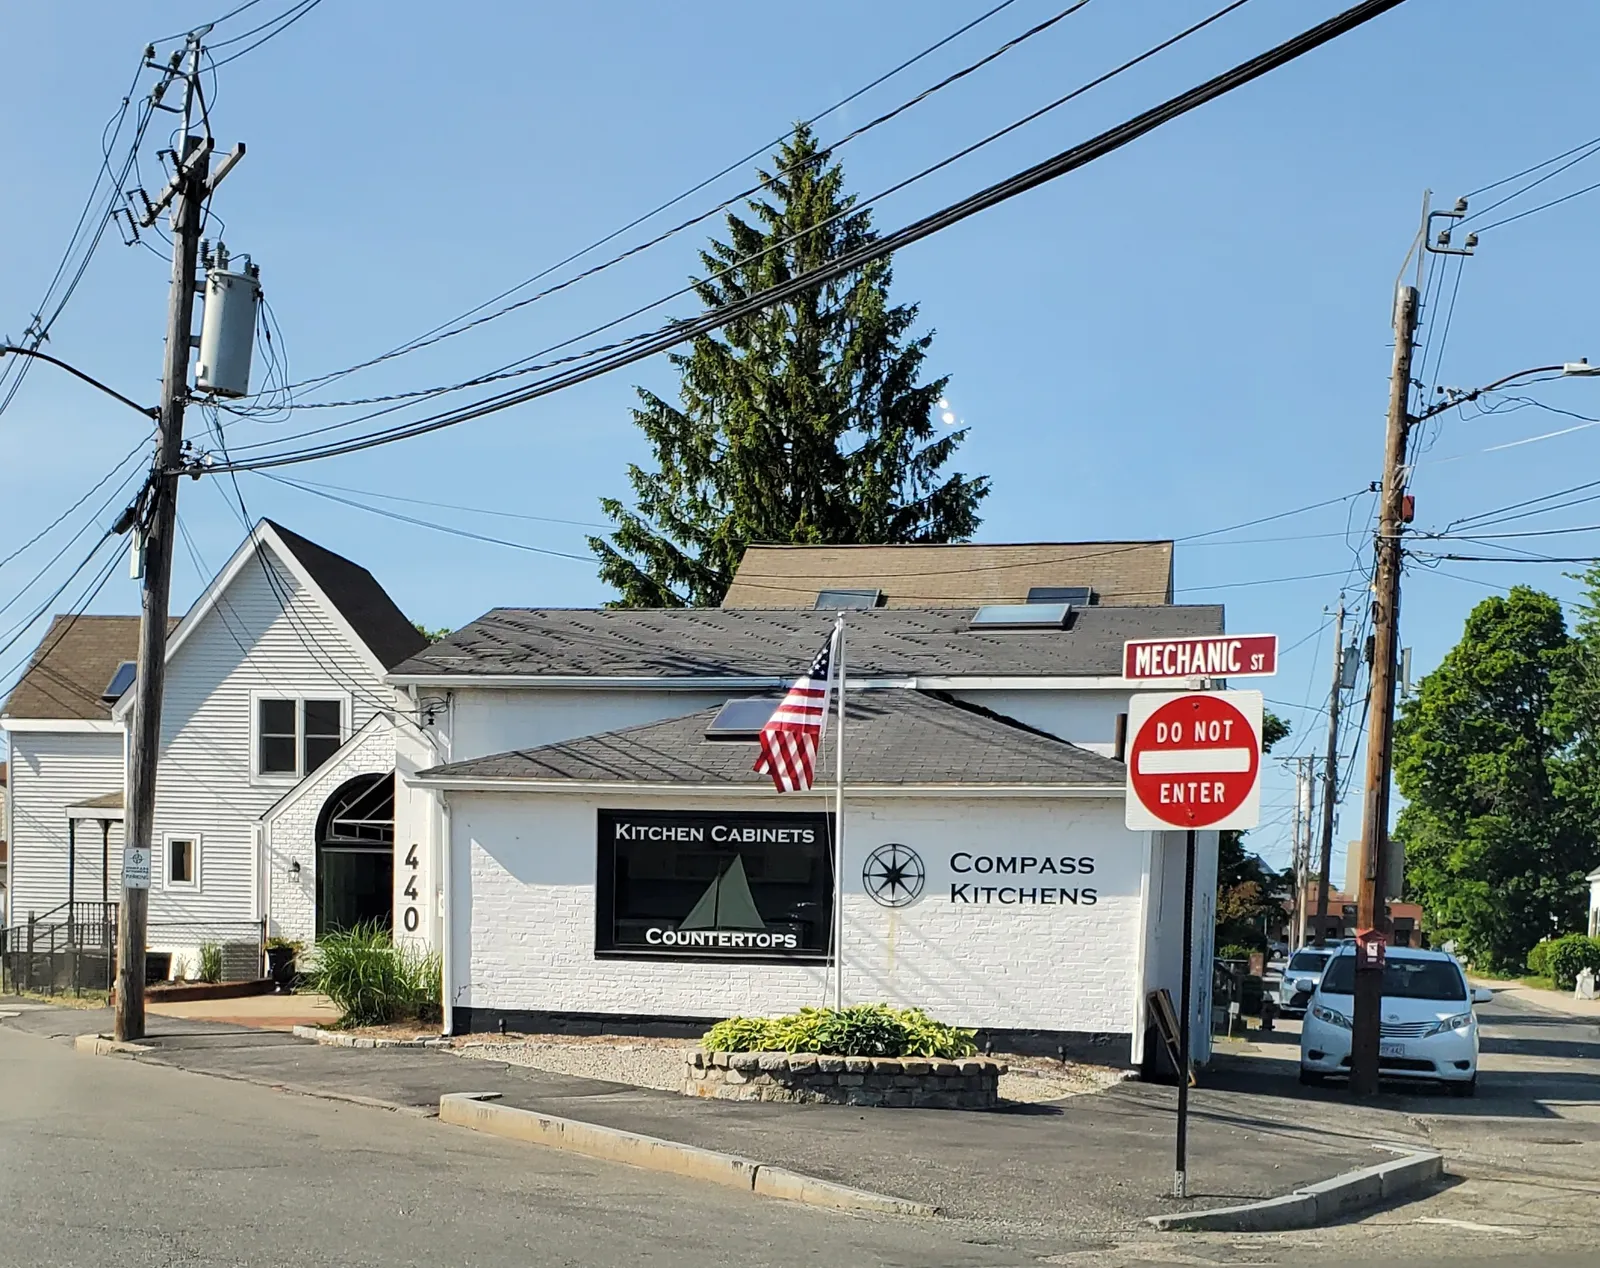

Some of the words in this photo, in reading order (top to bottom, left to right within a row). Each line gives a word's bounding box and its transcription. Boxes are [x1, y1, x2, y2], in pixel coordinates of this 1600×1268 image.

[1135, 641, 1242, 676] MECHANIC
[1250, 653, 1265, 671] ST
[1156, 721, 1183, 743] DO
[1194, 719, 1233, 742] NOT
[1160, 782, 1225, 804] ENTER
[404, 843, 419, 932] 440
